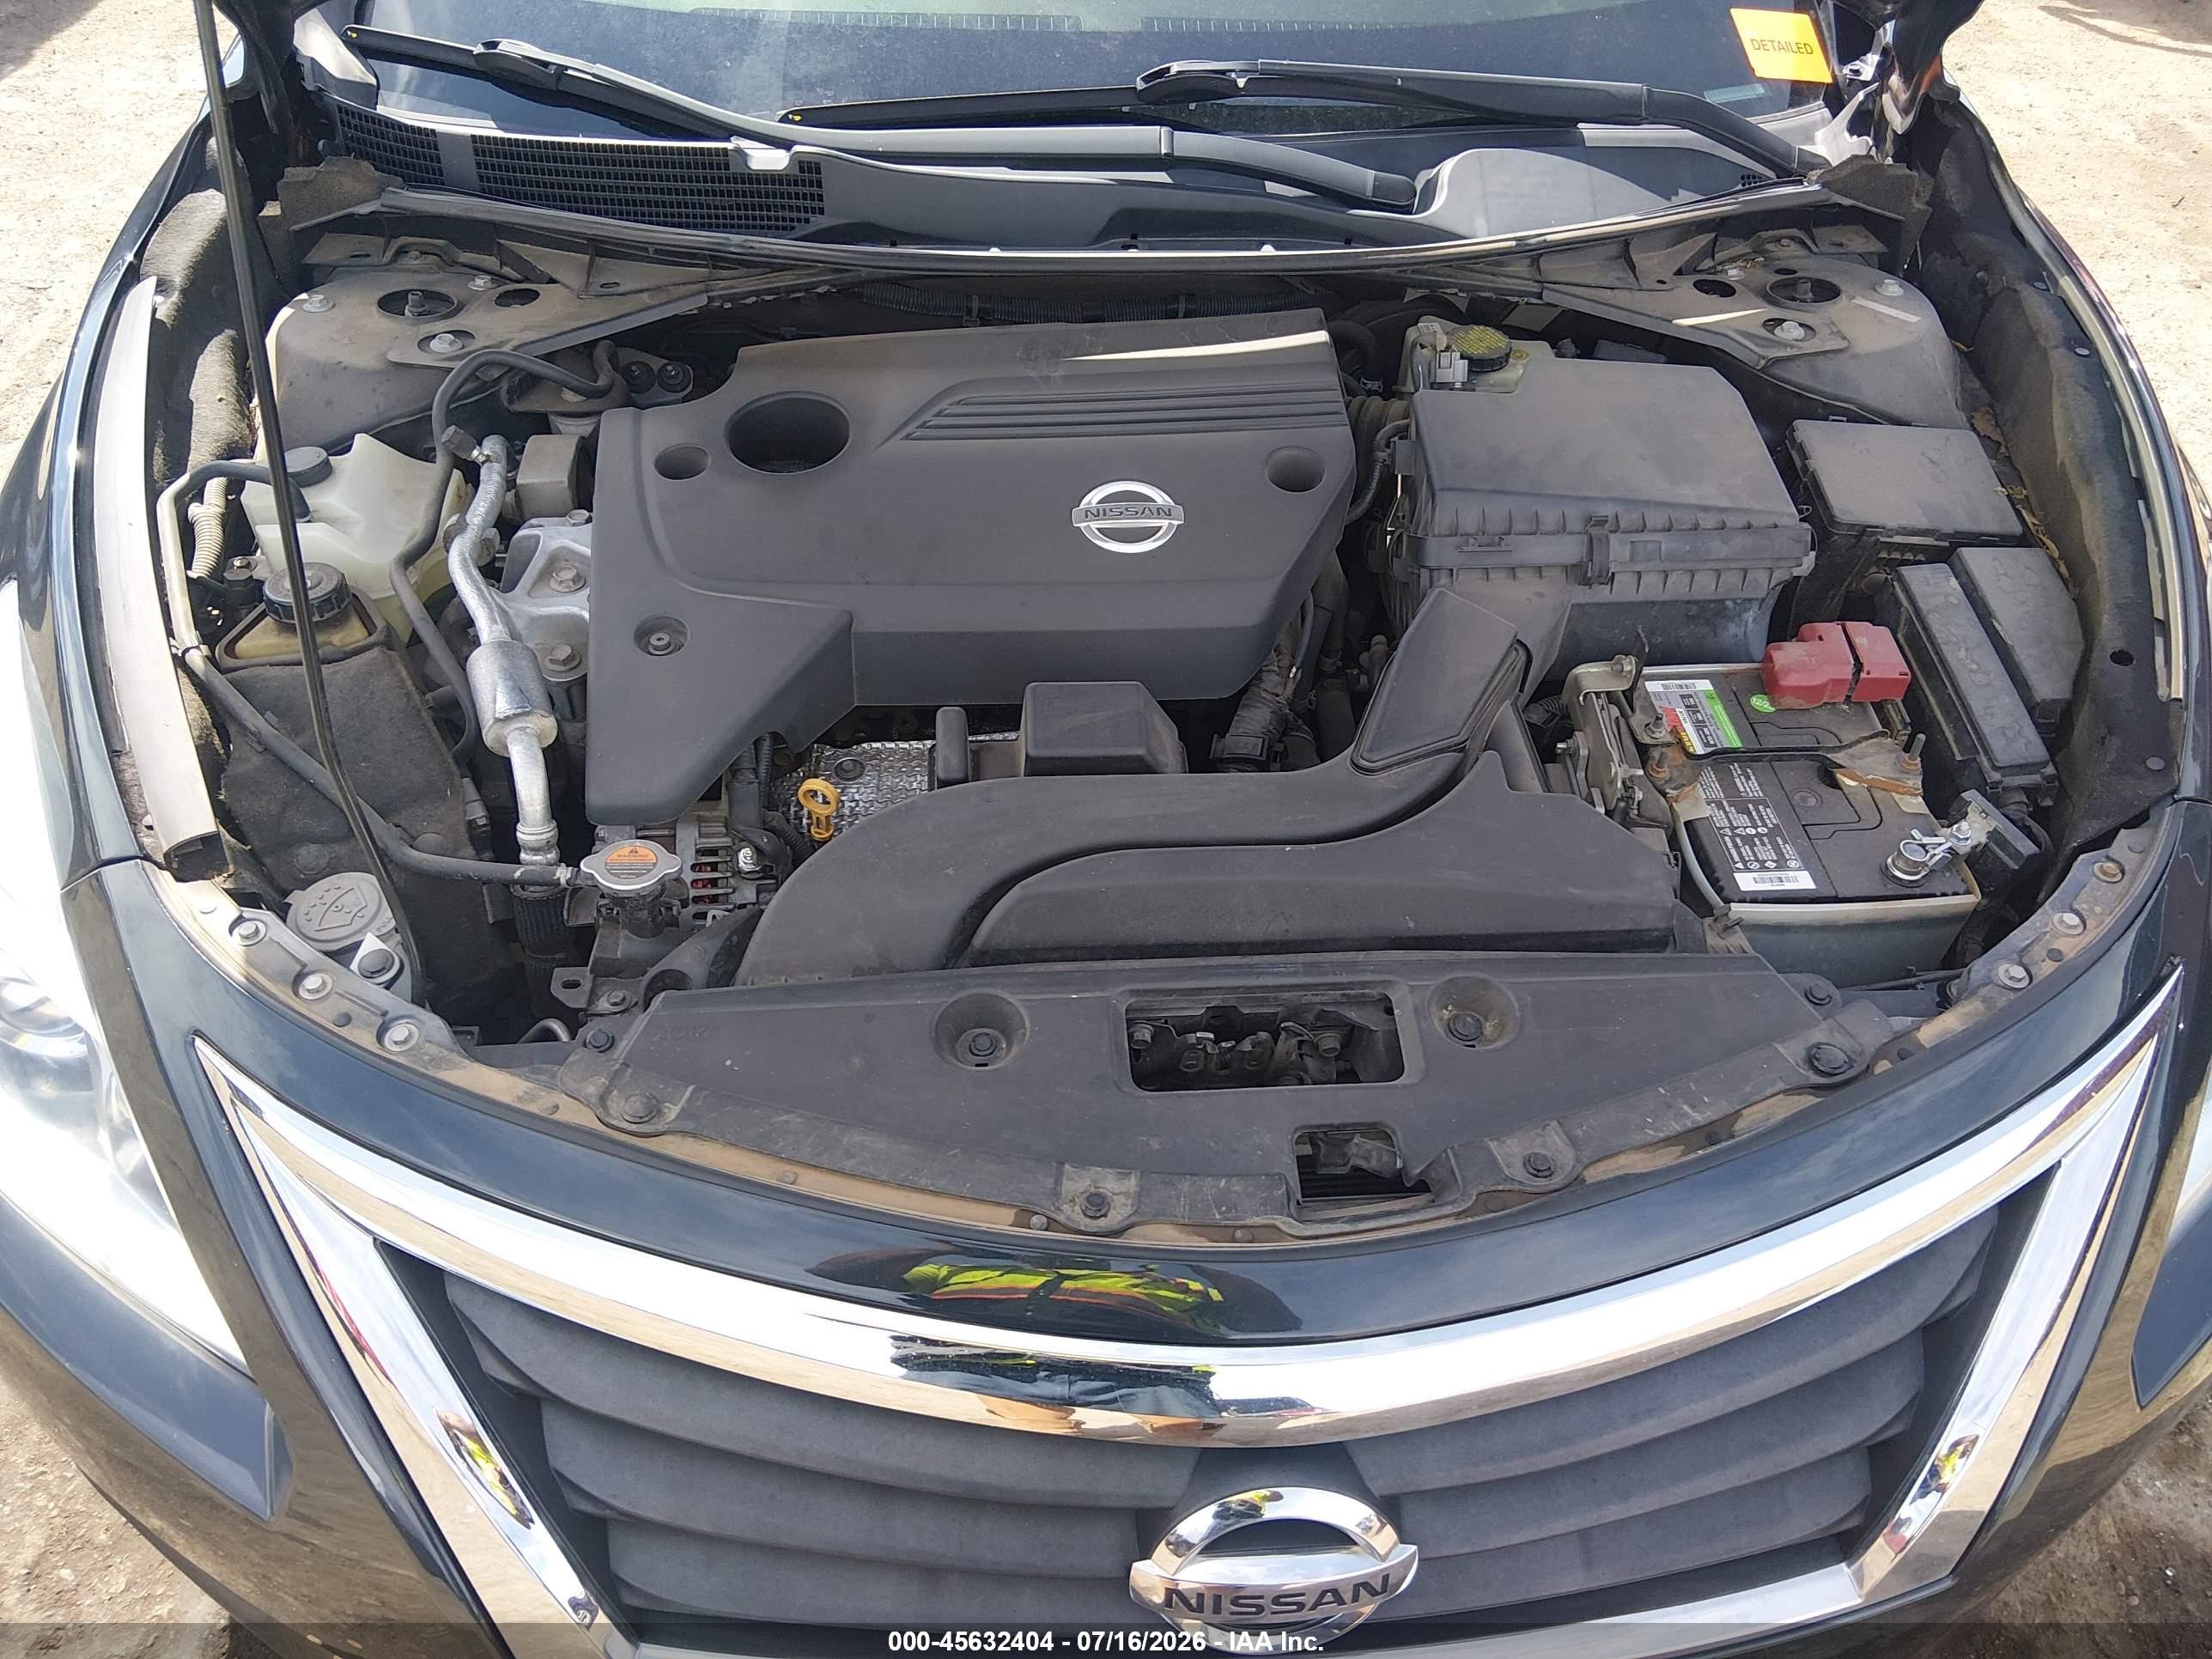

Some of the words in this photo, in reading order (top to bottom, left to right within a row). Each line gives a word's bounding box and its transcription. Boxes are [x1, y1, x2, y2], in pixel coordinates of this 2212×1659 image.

[1750, 38, 1814, 55] DETAILED
[1085, 507, 1172, 520] NISSAN
[1164, 1573, 1390, 1617] NISSAN
